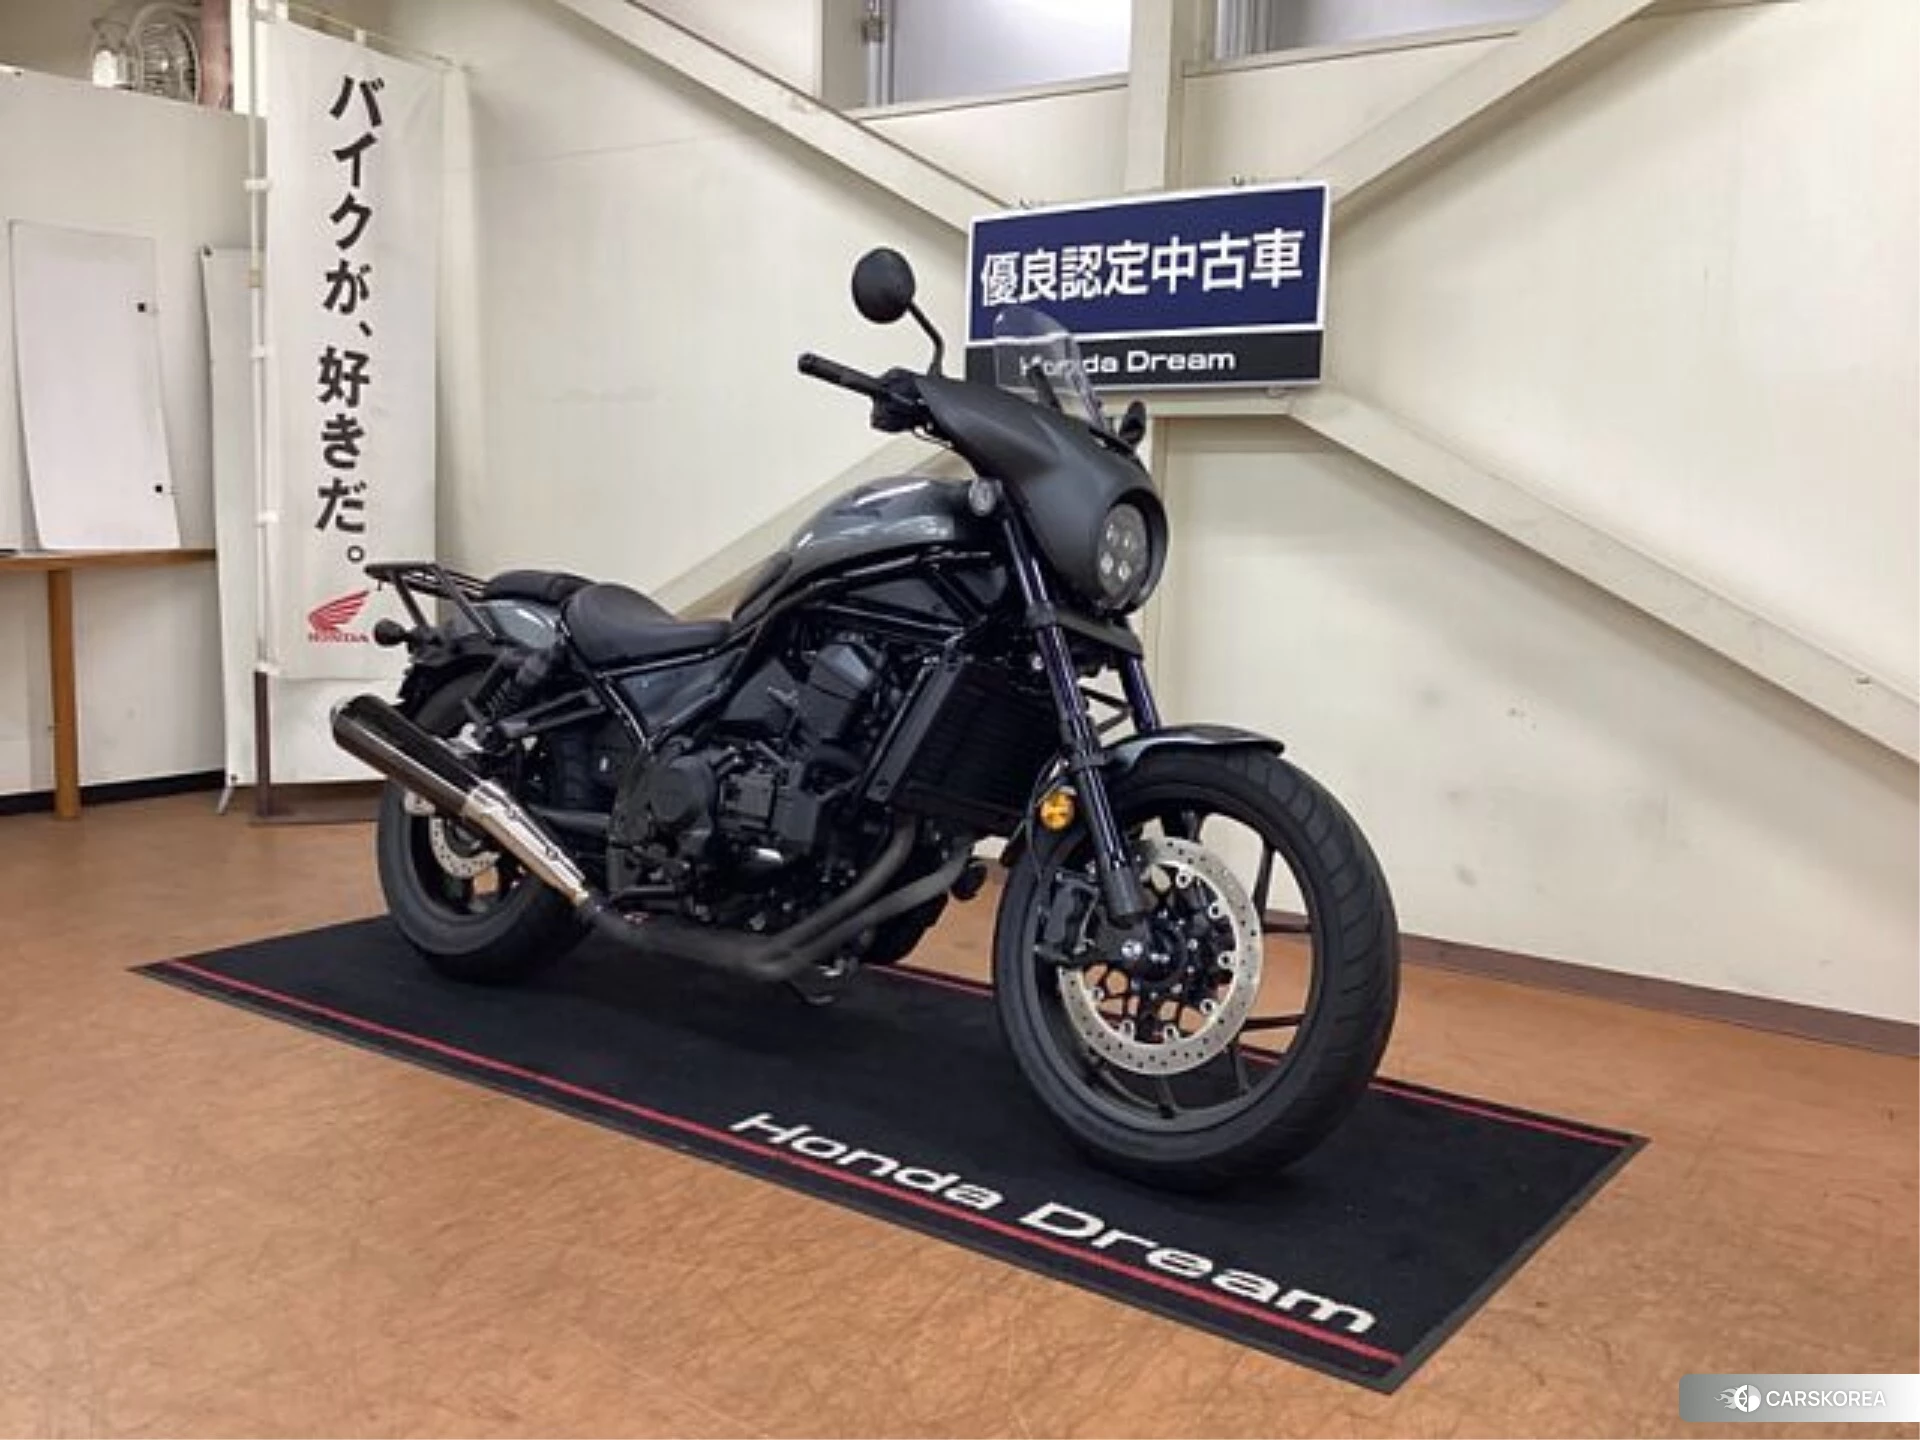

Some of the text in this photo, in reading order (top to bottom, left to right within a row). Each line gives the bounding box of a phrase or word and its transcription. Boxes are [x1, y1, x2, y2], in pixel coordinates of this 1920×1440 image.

[314, 73, 386, 564] バイクが、好きだ。
[980, 227, 1304, 306] 優良認定中古車
[1127, 350, 1236, 372] Dream
[730, 1112, 1377, 1335] Honda Dream
